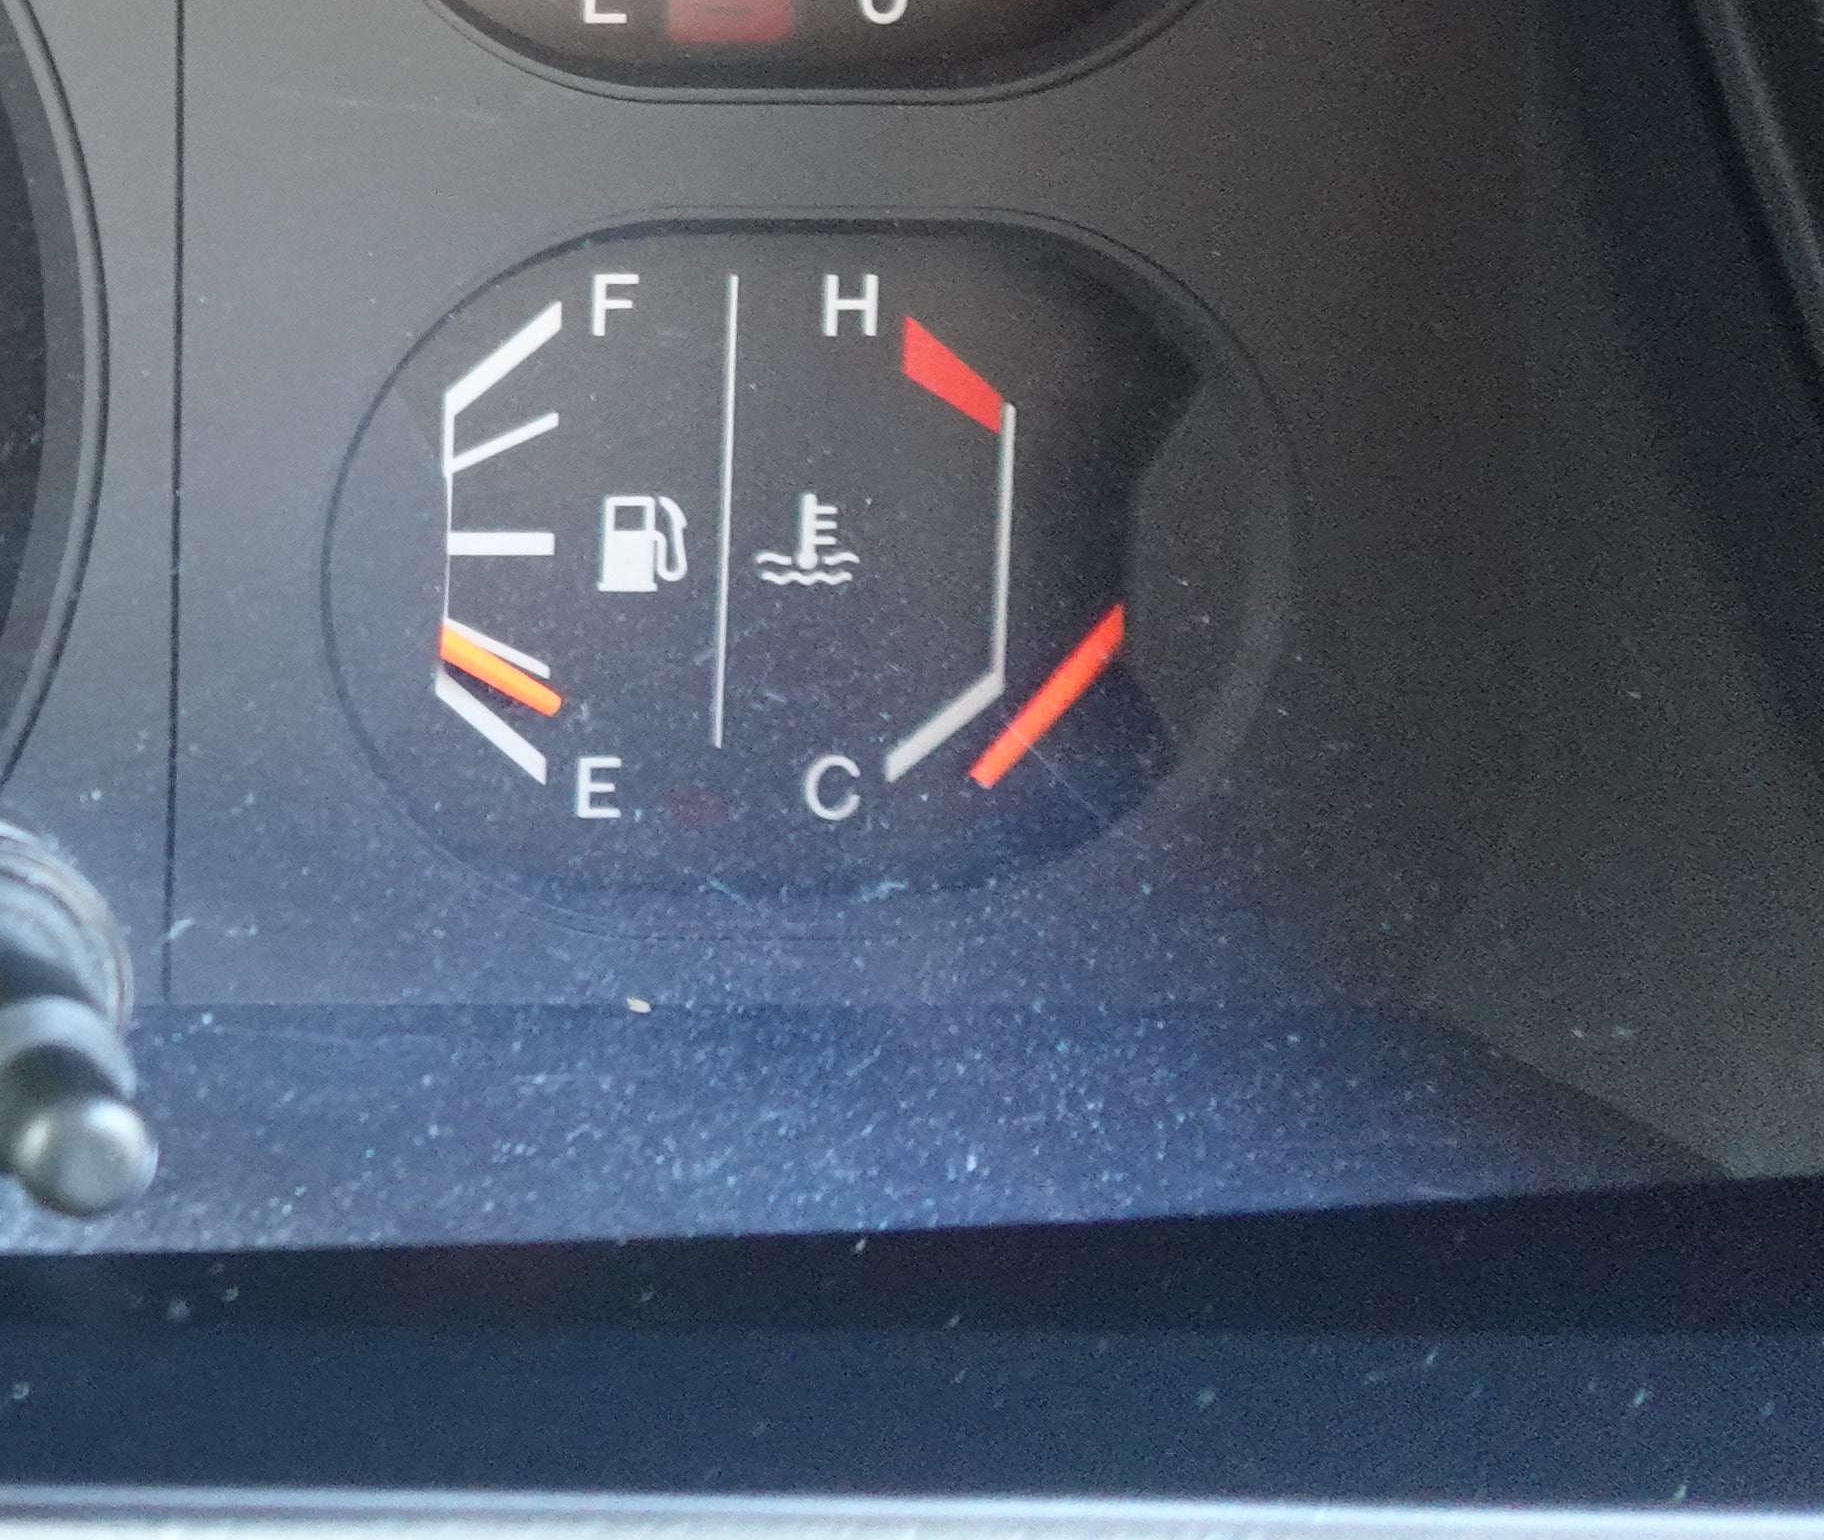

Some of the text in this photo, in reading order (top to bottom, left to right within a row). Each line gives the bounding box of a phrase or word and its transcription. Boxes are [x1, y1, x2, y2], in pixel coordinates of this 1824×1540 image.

[590, 271, 641, 338] F
[821, 272, 880, 338] H
[573, 754, 623, 820] E
[801, 753, 862, 822] C
